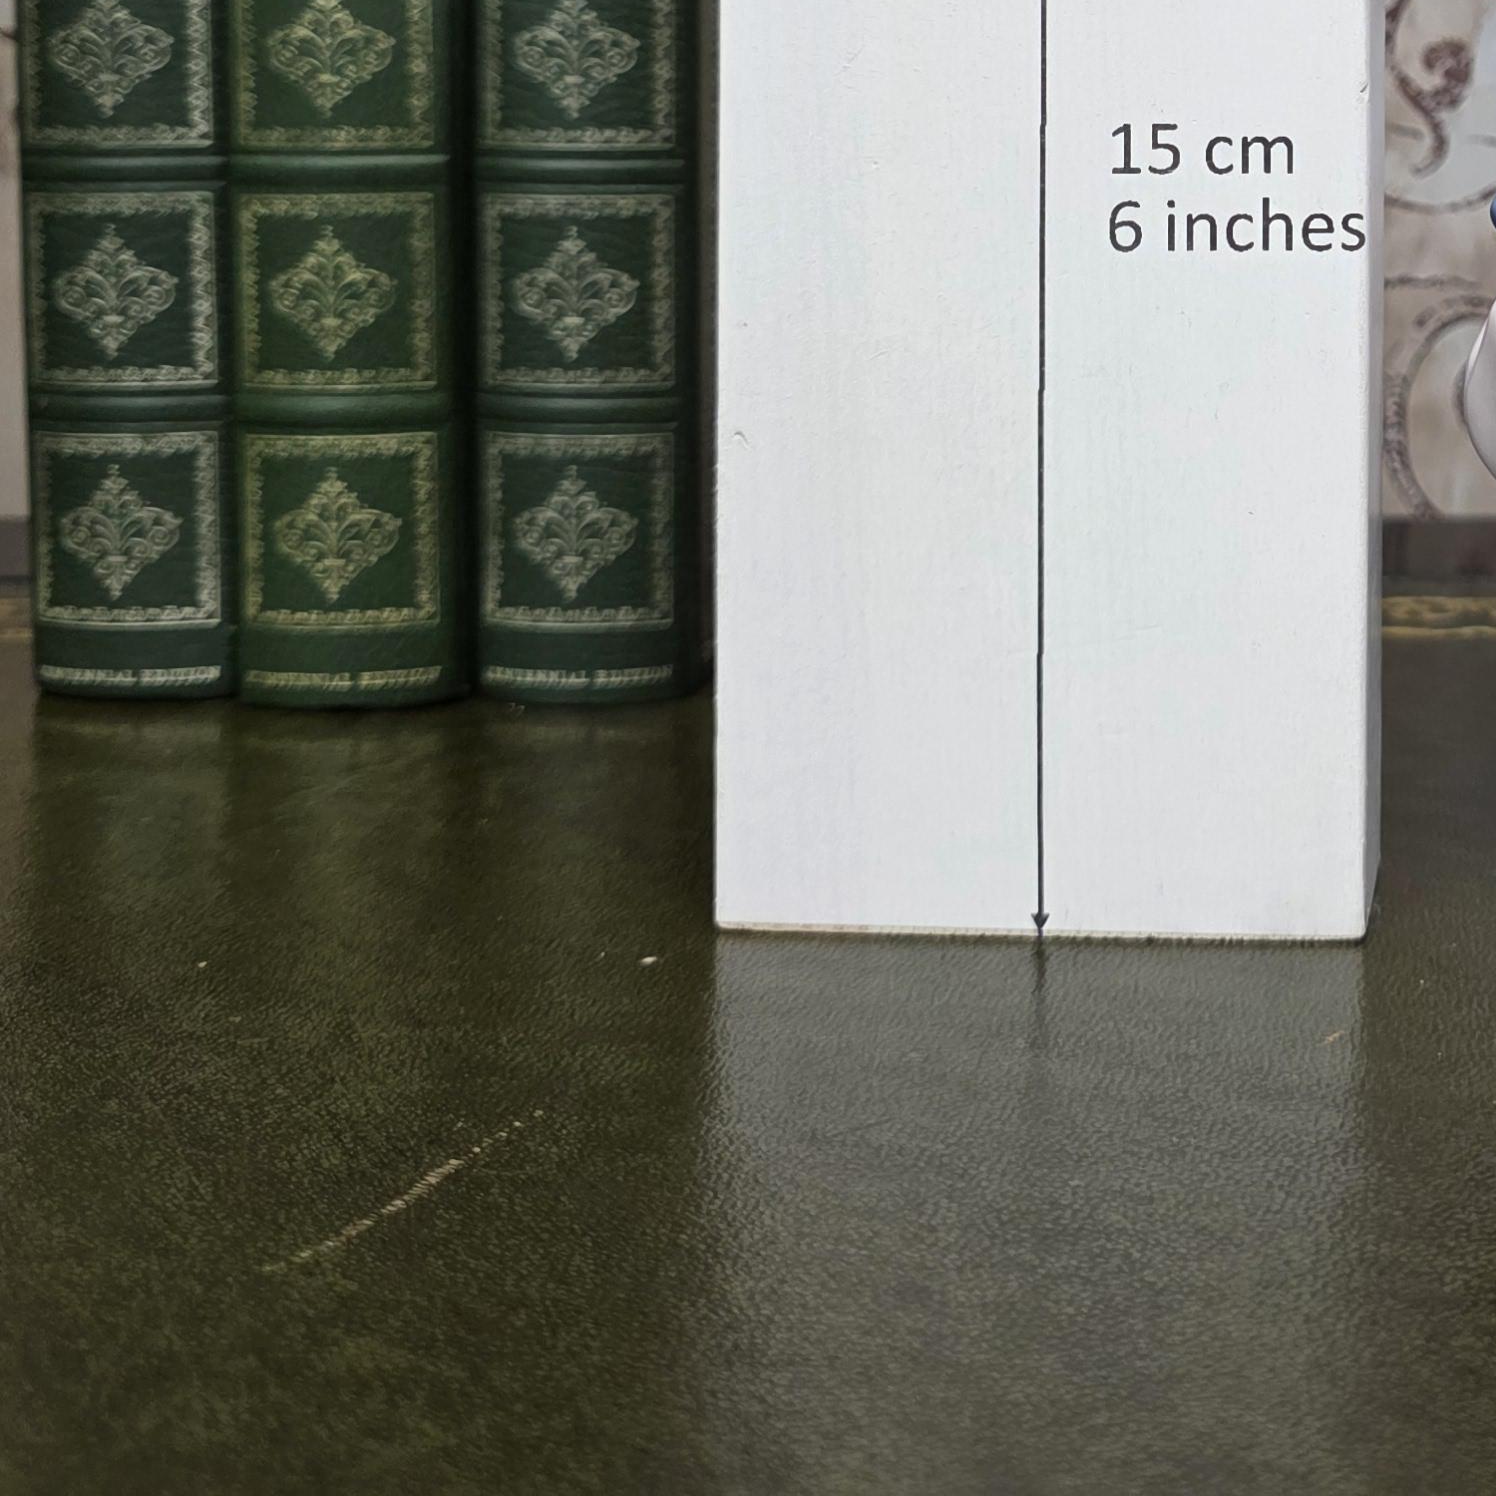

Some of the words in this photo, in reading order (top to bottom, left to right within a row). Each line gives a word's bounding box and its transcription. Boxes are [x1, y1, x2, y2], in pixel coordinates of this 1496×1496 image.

[1111, 123, 1181, 175] 15
[1205, 136, 1294, 175] cm
[1109, 200, 1142, 252] 6
[1166, 197, 1366, 252] inches
